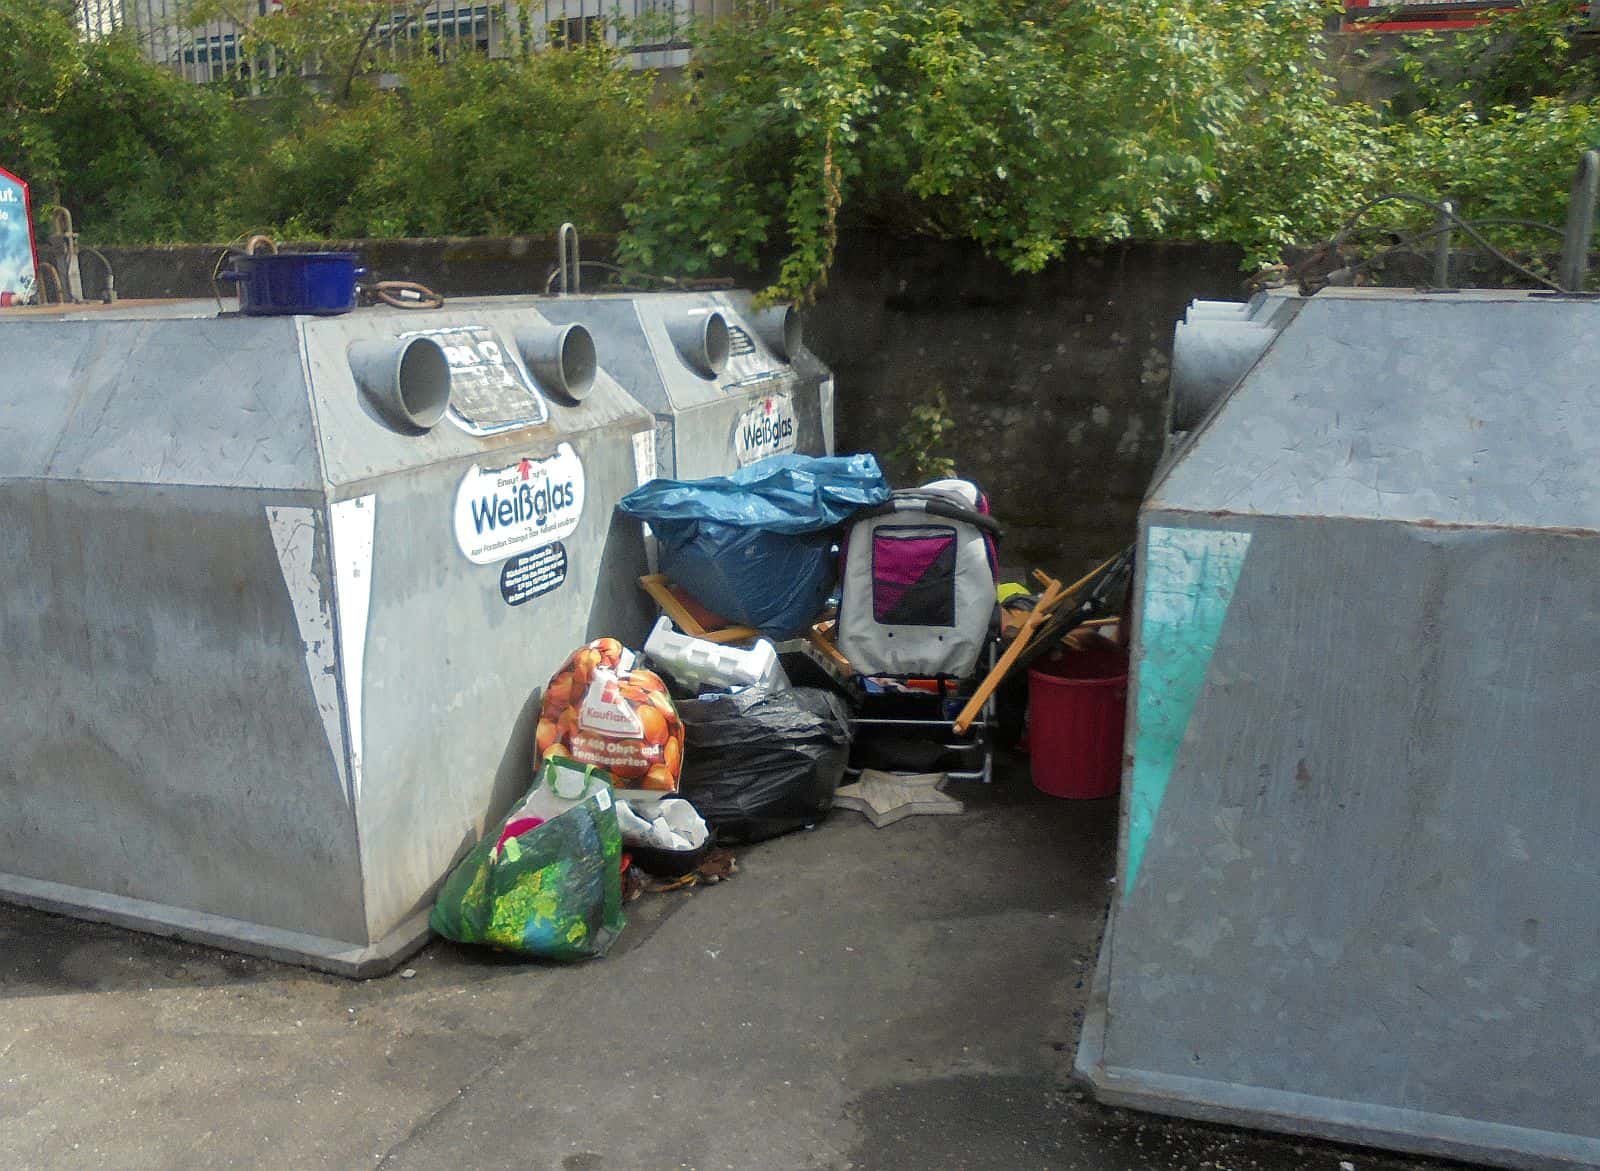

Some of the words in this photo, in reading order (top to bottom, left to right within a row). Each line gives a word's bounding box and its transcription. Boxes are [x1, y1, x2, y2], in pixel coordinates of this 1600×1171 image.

[743, 414, 793, 451] Weißglas
[471, 477, 574, 535] Weißglas
[641, 743, 660, 755] und
